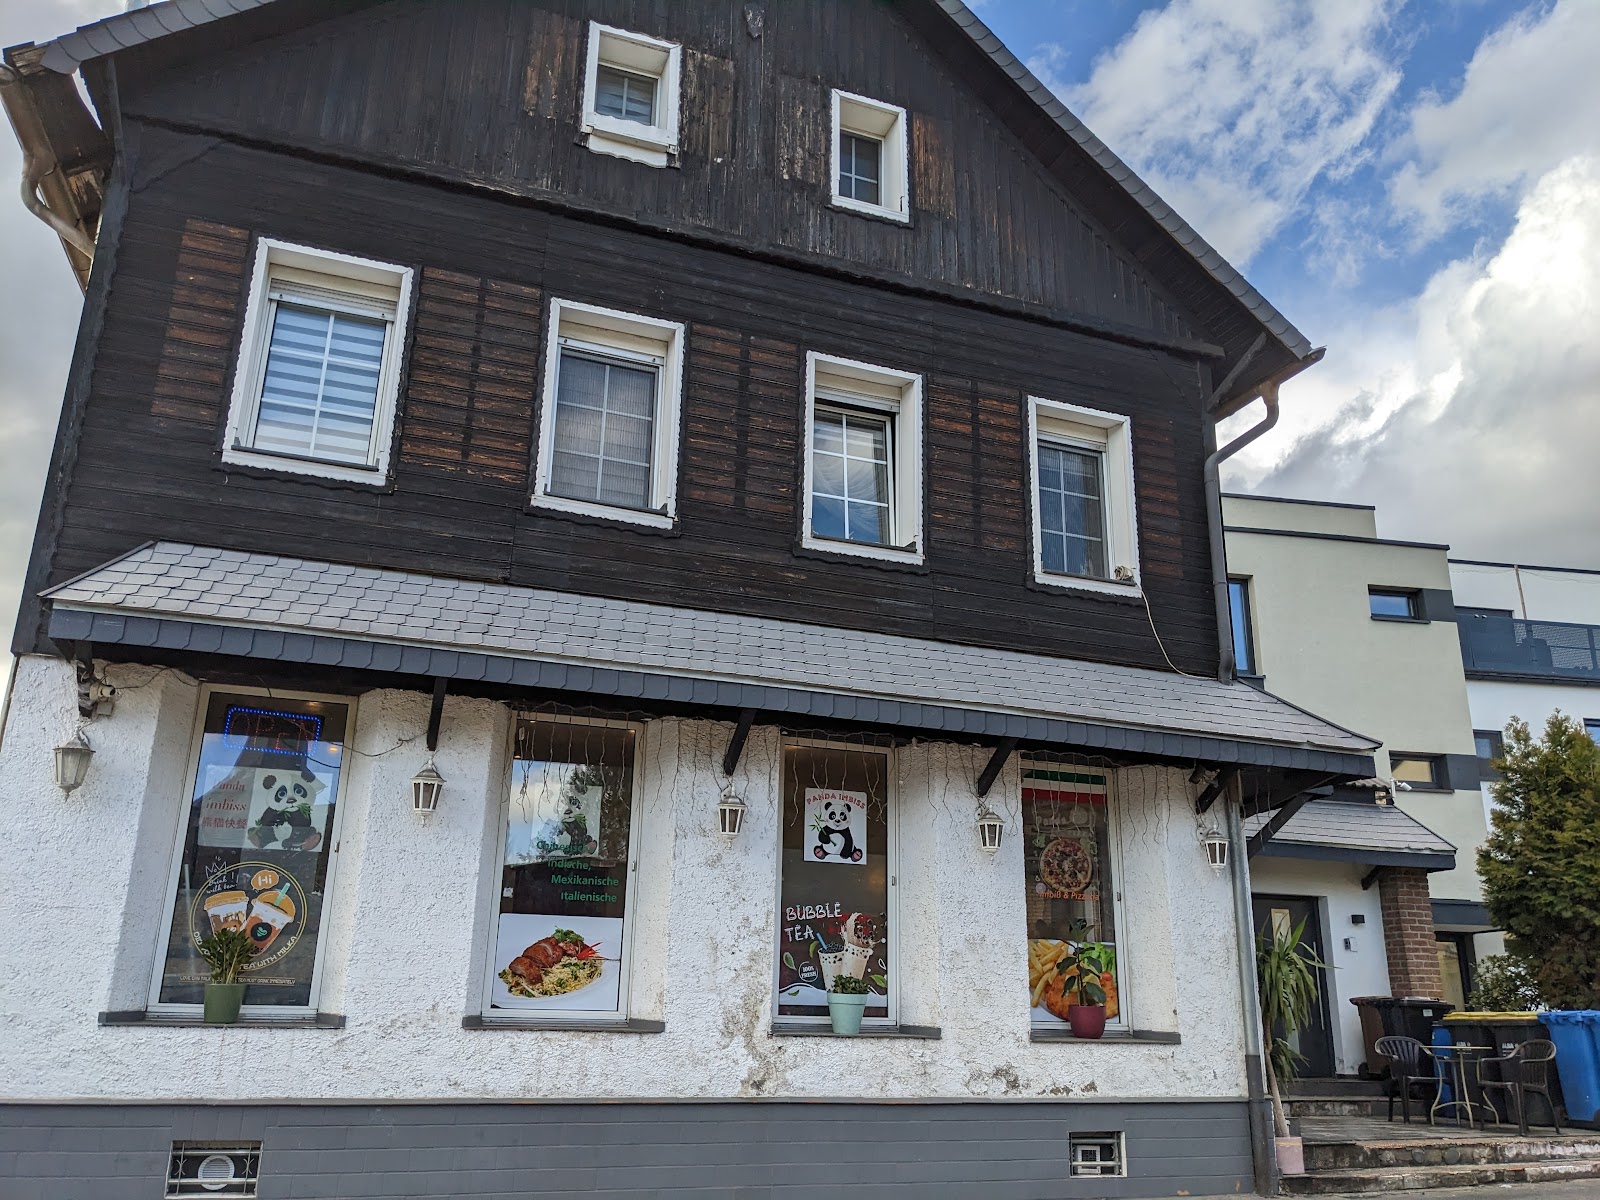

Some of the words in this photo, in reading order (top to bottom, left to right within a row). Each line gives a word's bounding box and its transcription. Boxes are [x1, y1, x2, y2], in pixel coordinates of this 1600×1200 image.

[206, 797, 247, 811] imbiss
[806, 792, 837, 805] PANDA
[838, 793, 866, 810] IMBISS
[258, 874, 273, 886] Hi
[551, 874, 619, 886] Mexikanische
[560, 890, 617, 902] Italienische
[1063, 890, 1069, 899] &
[786, 902, 843, 921] BUBBLE
[784, 924, 815, 942] TEA
[257, 955, 277, 967] WITH
